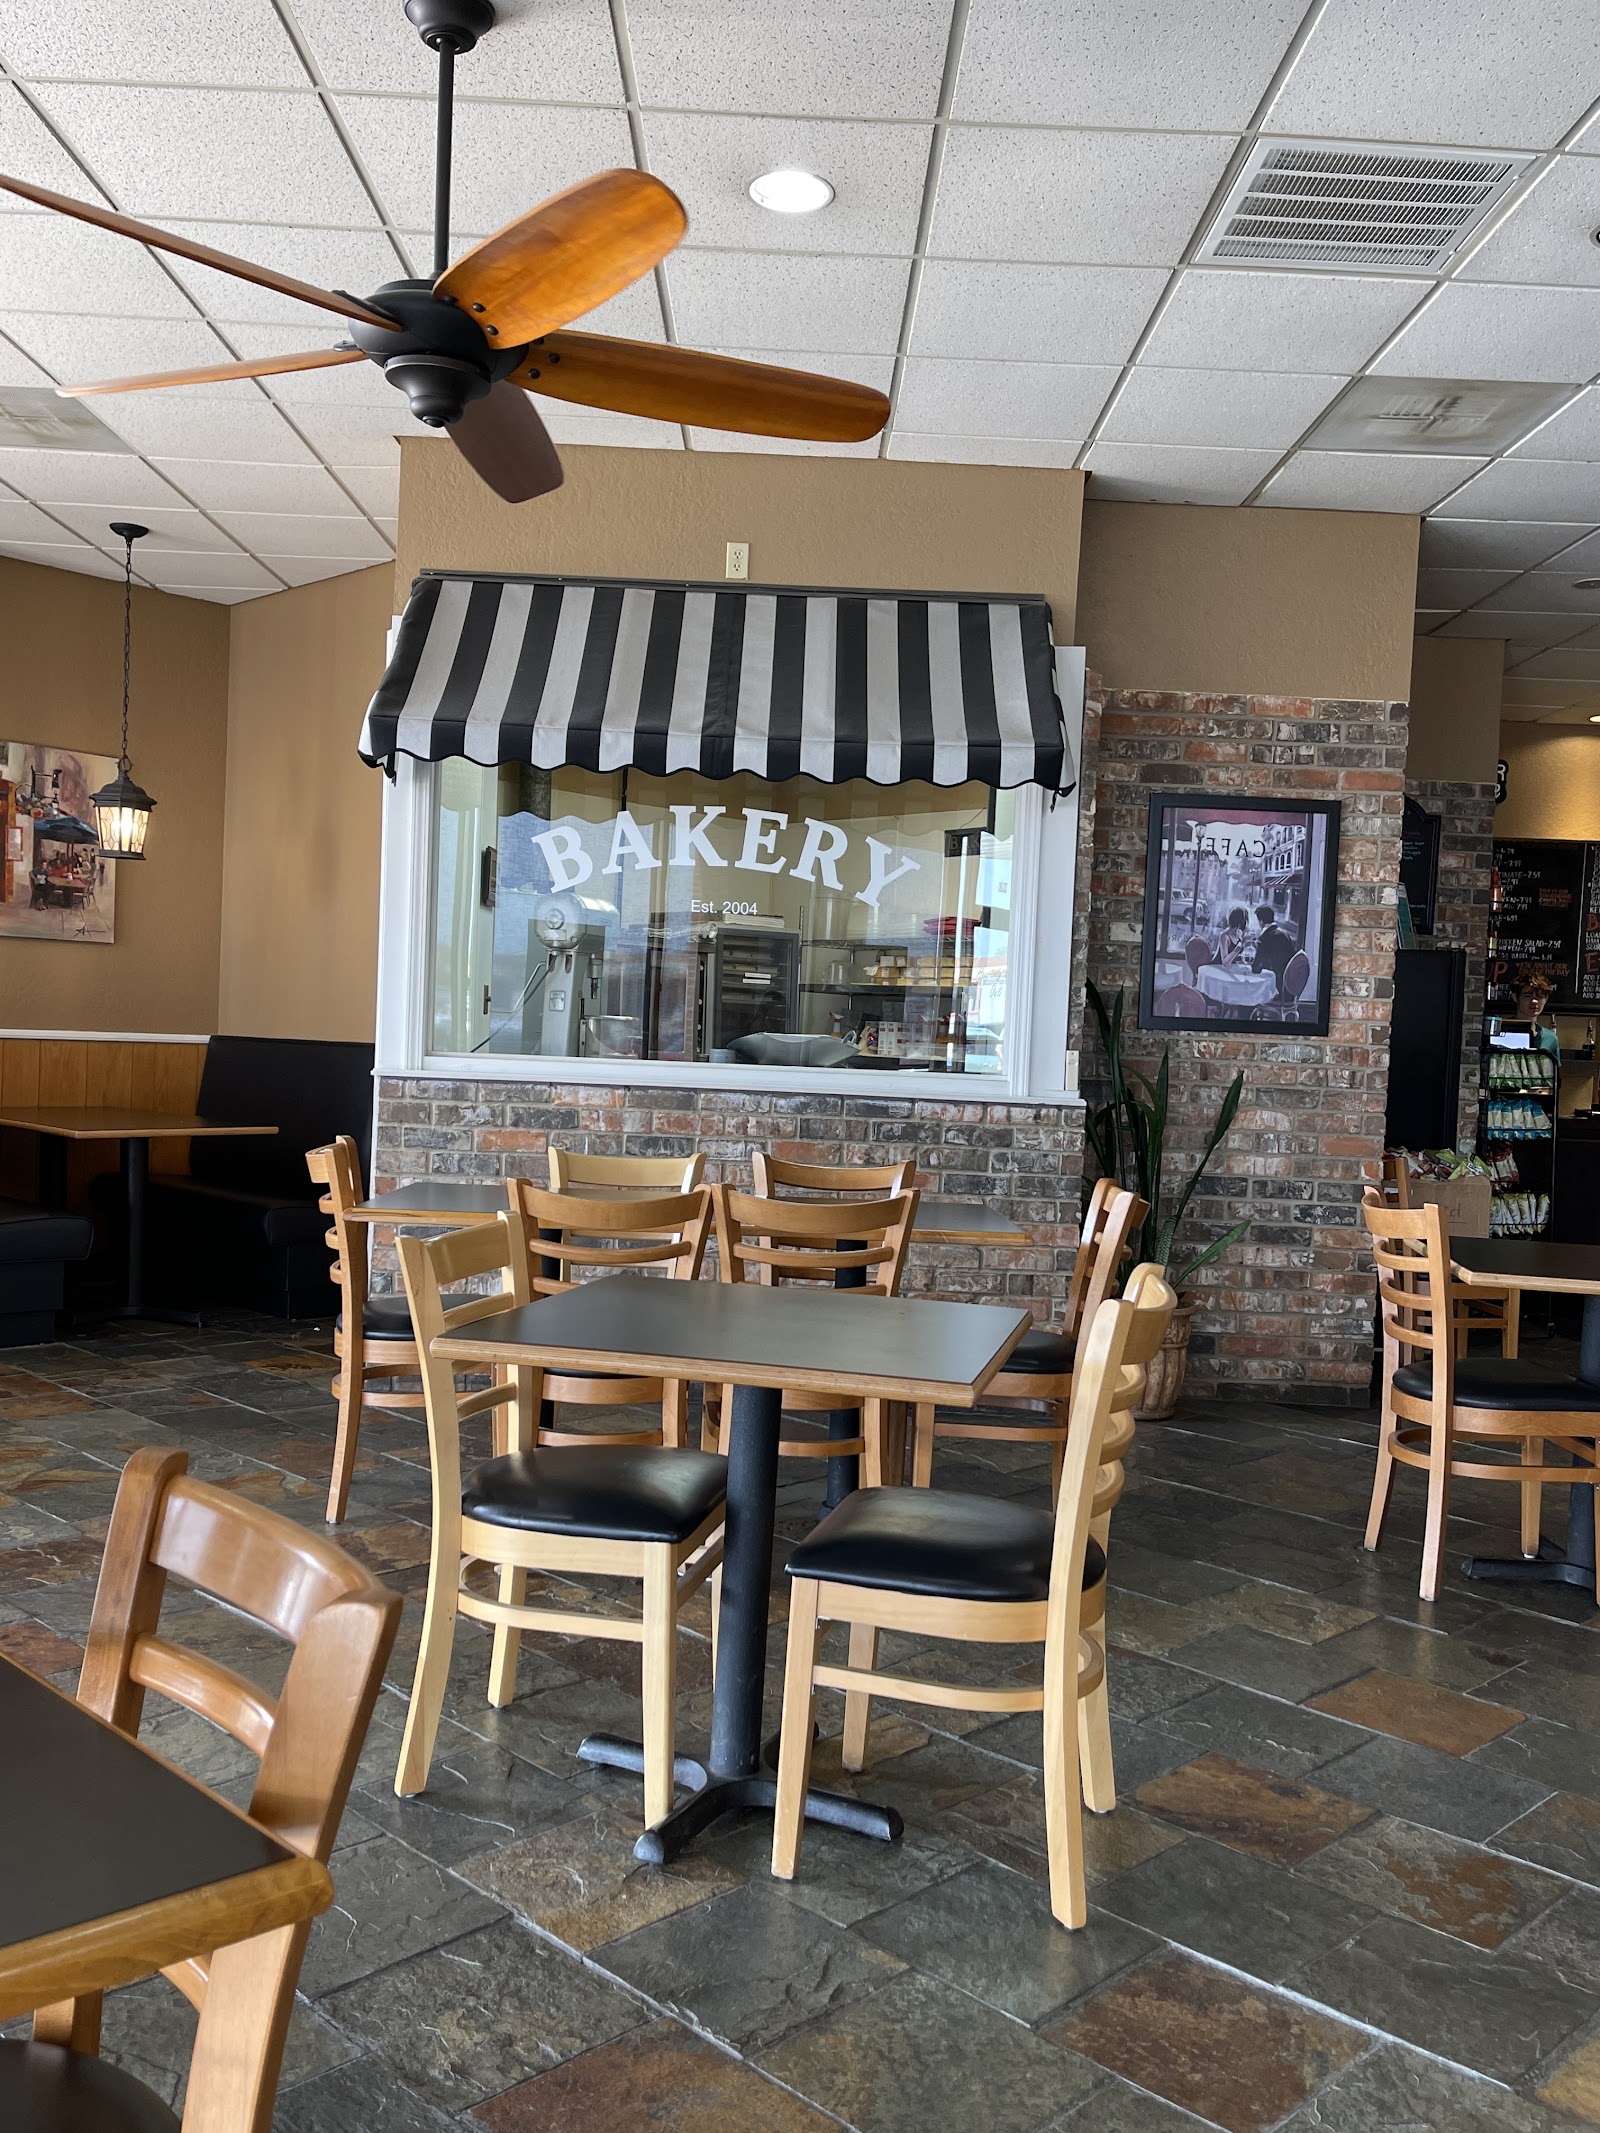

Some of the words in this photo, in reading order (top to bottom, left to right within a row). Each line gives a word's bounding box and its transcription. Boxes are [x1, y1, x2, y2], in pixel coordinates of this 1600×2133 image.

[531, 805, 921, 909] BAKERY
[690, 899, 718, 914] Est.
[722, 901, 758, 916] 2004
